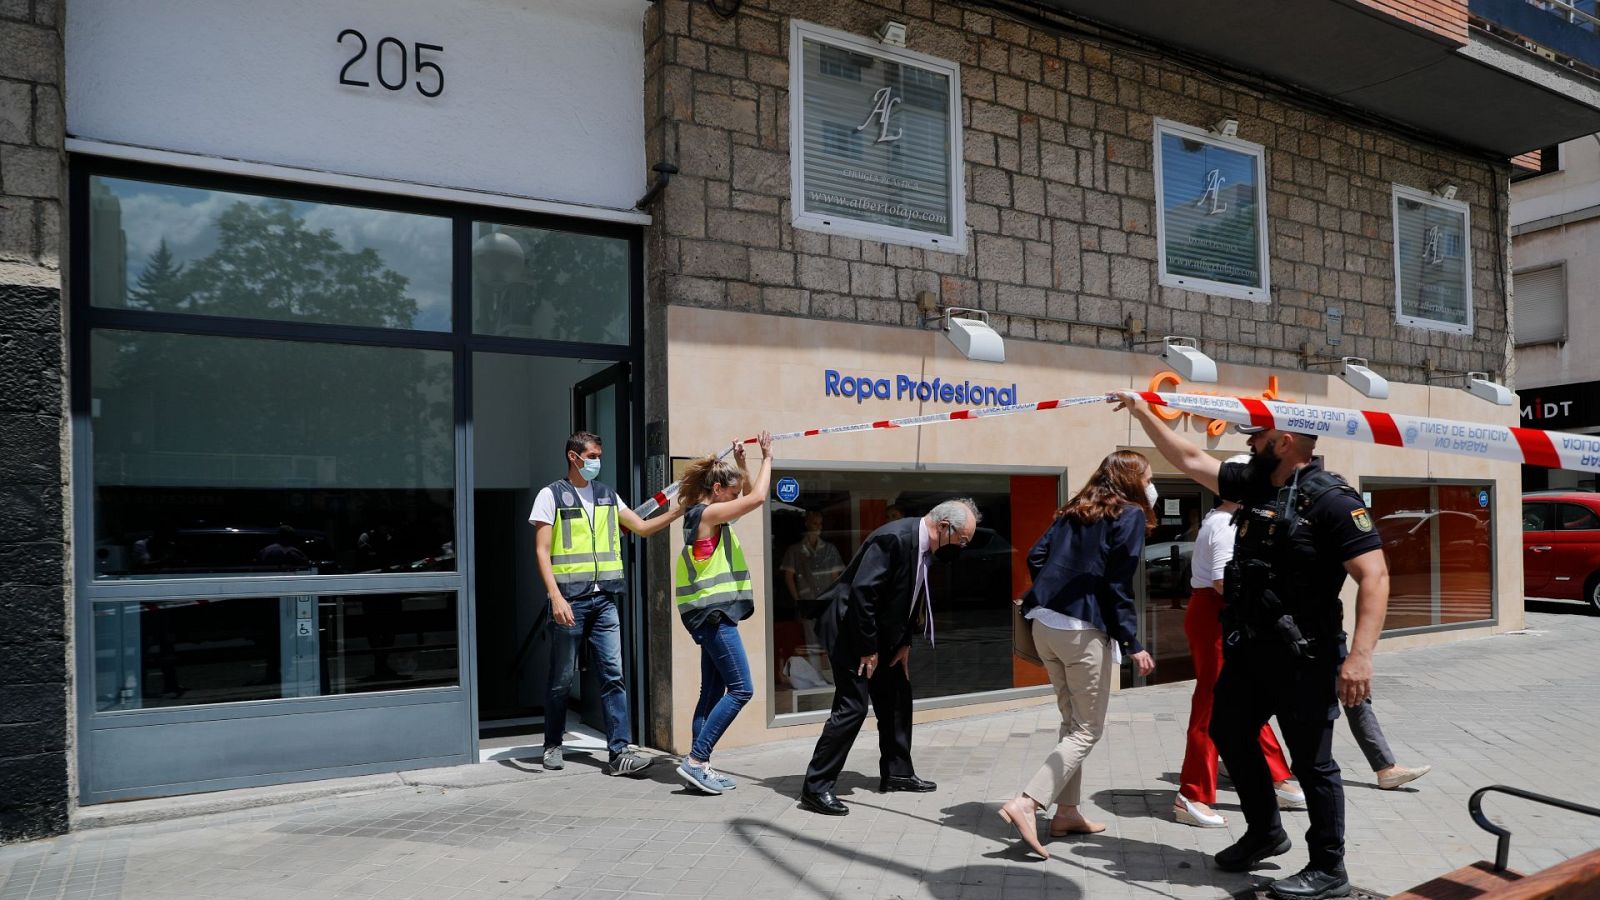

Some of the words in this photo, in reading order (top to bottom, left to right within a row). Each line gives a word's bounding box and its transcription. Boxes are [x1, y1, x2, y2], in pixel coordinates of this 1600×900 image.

[337, 29, 444, 98] 205
[857, 86, 903, 142] AL
[1197, 168, 1227, 215] AL
[809, 191, 947, 224] www.albertolajo.com
[825, 369, 890, 404] Ropa
[896, 374, 1017, 406] Profesional
[1274, 405, 1305, 417] POLICIA
[1308, 408, 1319, 418] DE
[1321, 410, 1346, 421] LINEA
[1288, 417, 1315, 430] PASAR
[1317, 420, 1331, 431] NO
[1581, 455, 1600, 468] AR
[780, 484, 796, 493] ADT
